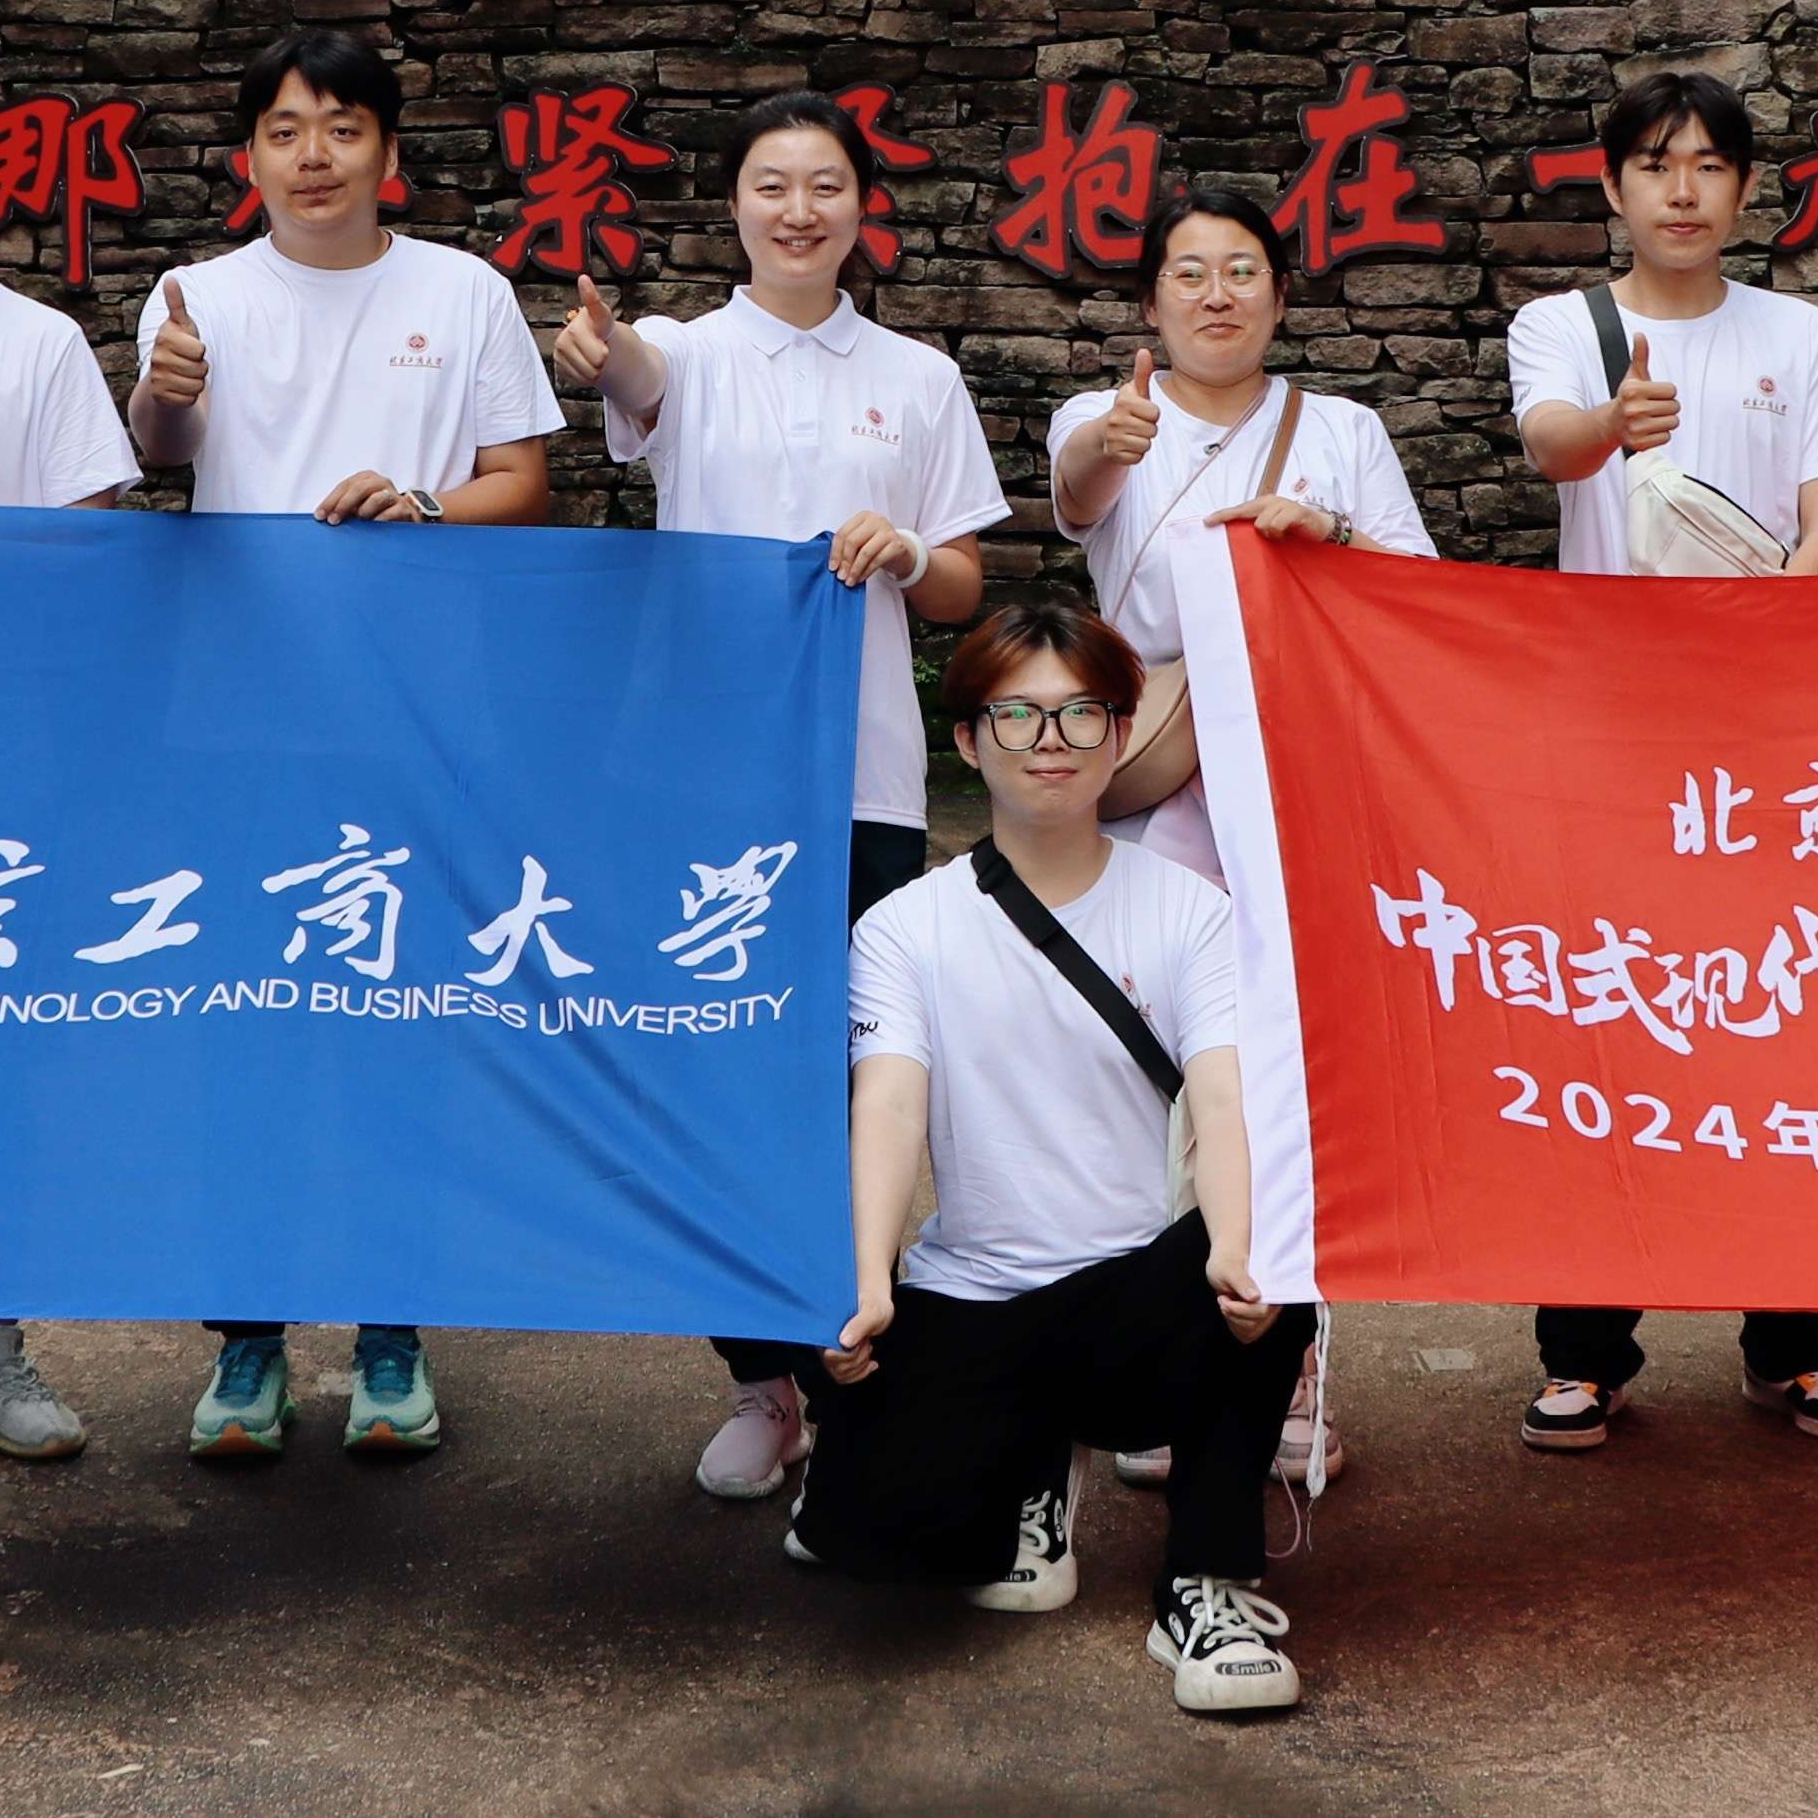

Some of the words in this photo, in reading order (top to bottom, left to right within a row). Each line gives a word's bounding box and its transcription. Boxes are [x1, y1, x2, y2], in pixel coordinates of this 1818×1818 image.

[200, 978, 299, 1014] AND
[310, 982, 527, 1029] BUSINESS
[539, 987, 794, 1035] UNIVERSITY
